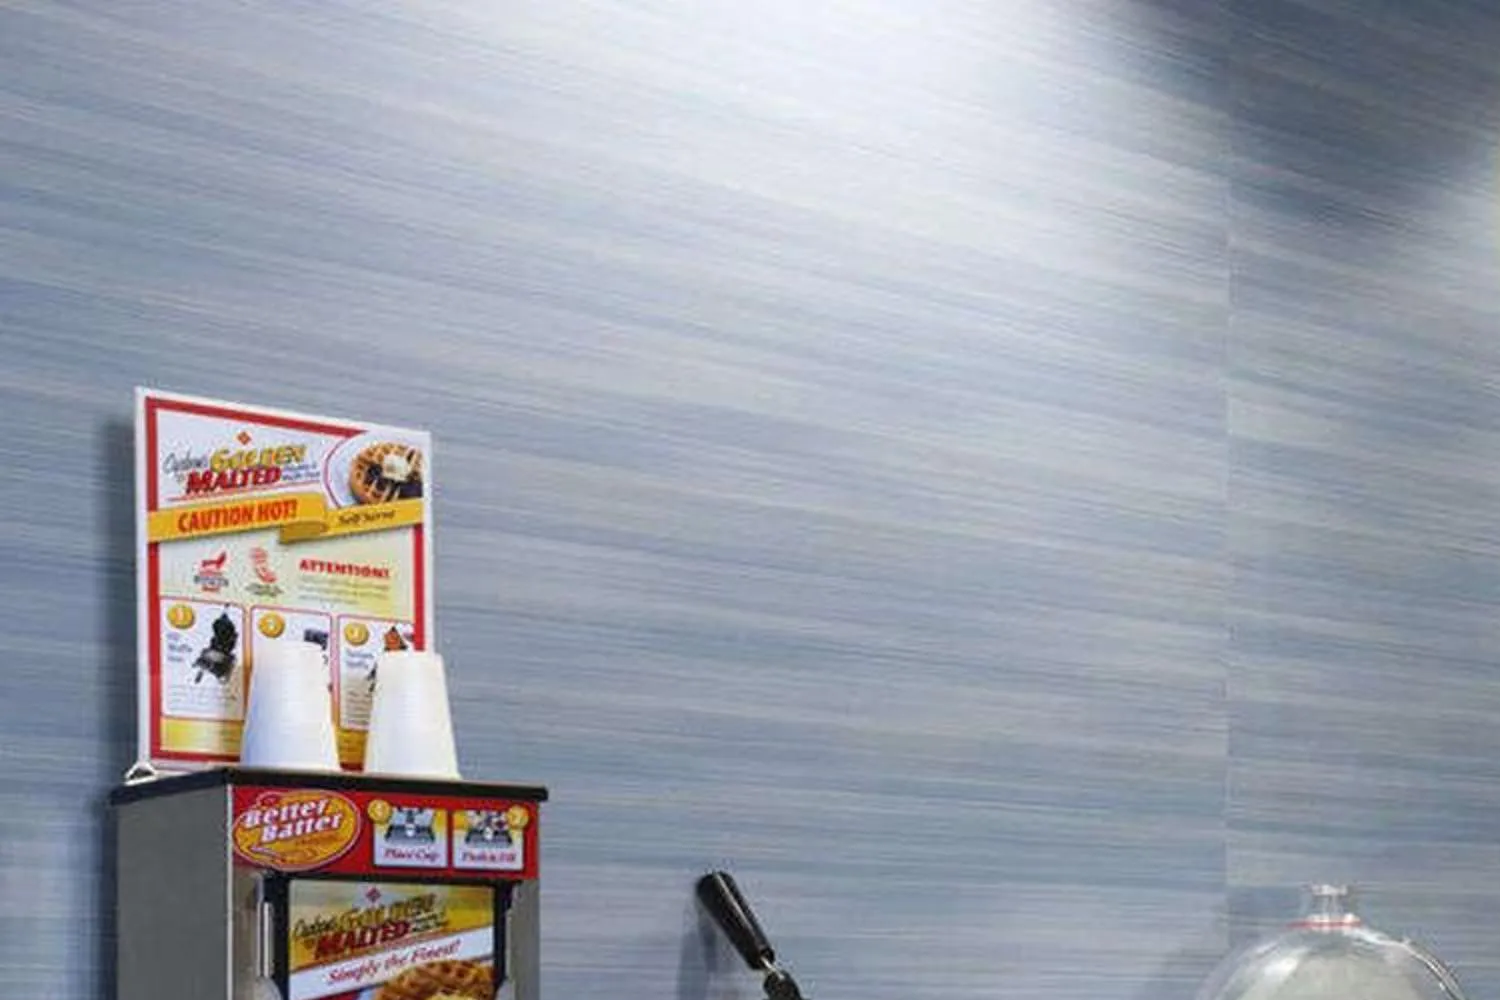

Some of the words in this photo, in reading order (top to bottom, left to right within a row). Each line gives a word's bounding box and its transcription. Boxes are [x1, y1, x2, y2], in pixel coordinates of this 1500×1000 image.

[186, 466, 282, 494] MALTED
[178, 507, 252, 533] CAUTION
[253, 499, 298, 523] HOT!
[299, 558, 391, 578] ATTENTION!
[243, 800, 328, 830] Better
[261, 814, 343, 844] Batter
[414, 848, 439, 862] Cup
[315, 918, 411, 961] MALTED
[328, 959, 382, 984] Simply
